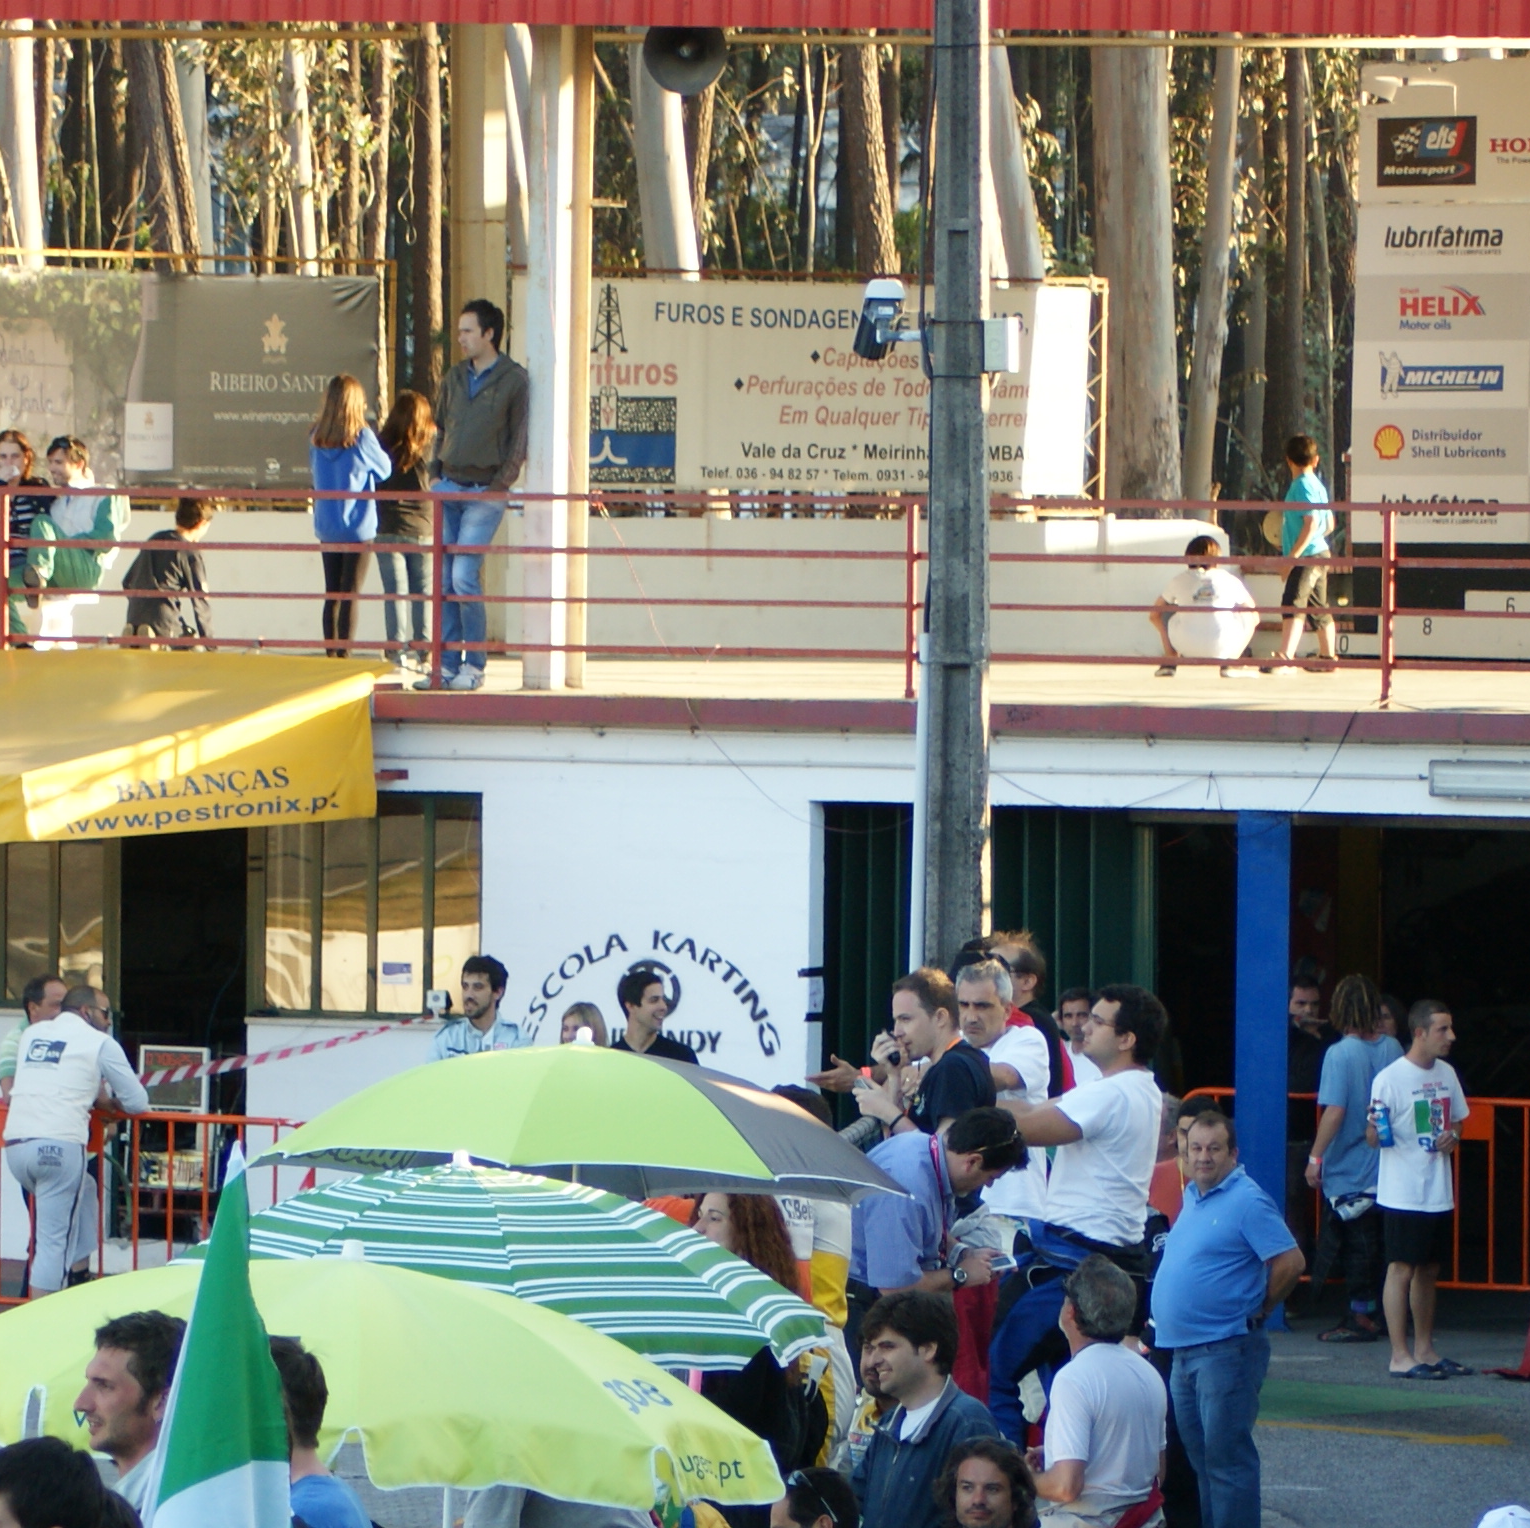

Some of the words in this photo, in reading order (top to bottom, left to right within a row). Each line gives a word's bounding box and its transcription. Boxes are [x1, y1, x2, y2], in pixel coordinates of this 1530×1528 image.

[1496, 156, 1511, 164] The
[1383, 164, 1456, 176] Motorsport
[655, 302, 725, 325] FUROS
[732, 307, 743, 326] E
[1399, 296, 1481, 316] HELIX
[1399, 319, 1429, 330] Motor
[1434, 319, 1451, 330] oils
[746, 375, 857, 396] Perfurações
[863, 378, 885, 396] de
[1405, 370, 1499, 385] MICHELIN
[779, 405, 808, 424] Em
[815, 405, 900, 430] Qualquer
[1412, 429, 1483, 441] Distribuidor
[741, 442, 776, 458] Vale
[782, 443, 801, 458] da
[807, 443, 846, 459] Cruz
[1412, 447, 1440, 458] Shell
[1444, 447, 1506, 458] Lubricants
[700, 466, 732, 479] Telef.
[736, 468, 758, 479] 036
[770, 468, 783, 480] 94
[788, 469, 802, 480] 82
[806, 469, 819, 480] 57
[833, 469, 872, 481] Telem.
[877, 470, 905, 481] 0931
[1506, 597, 1515, 613] 6
[1422, 617, 1432, 635] 8
[117, 766, 289, 804] BALANÇAS
[652, 930, 781, 1058] KARTING
